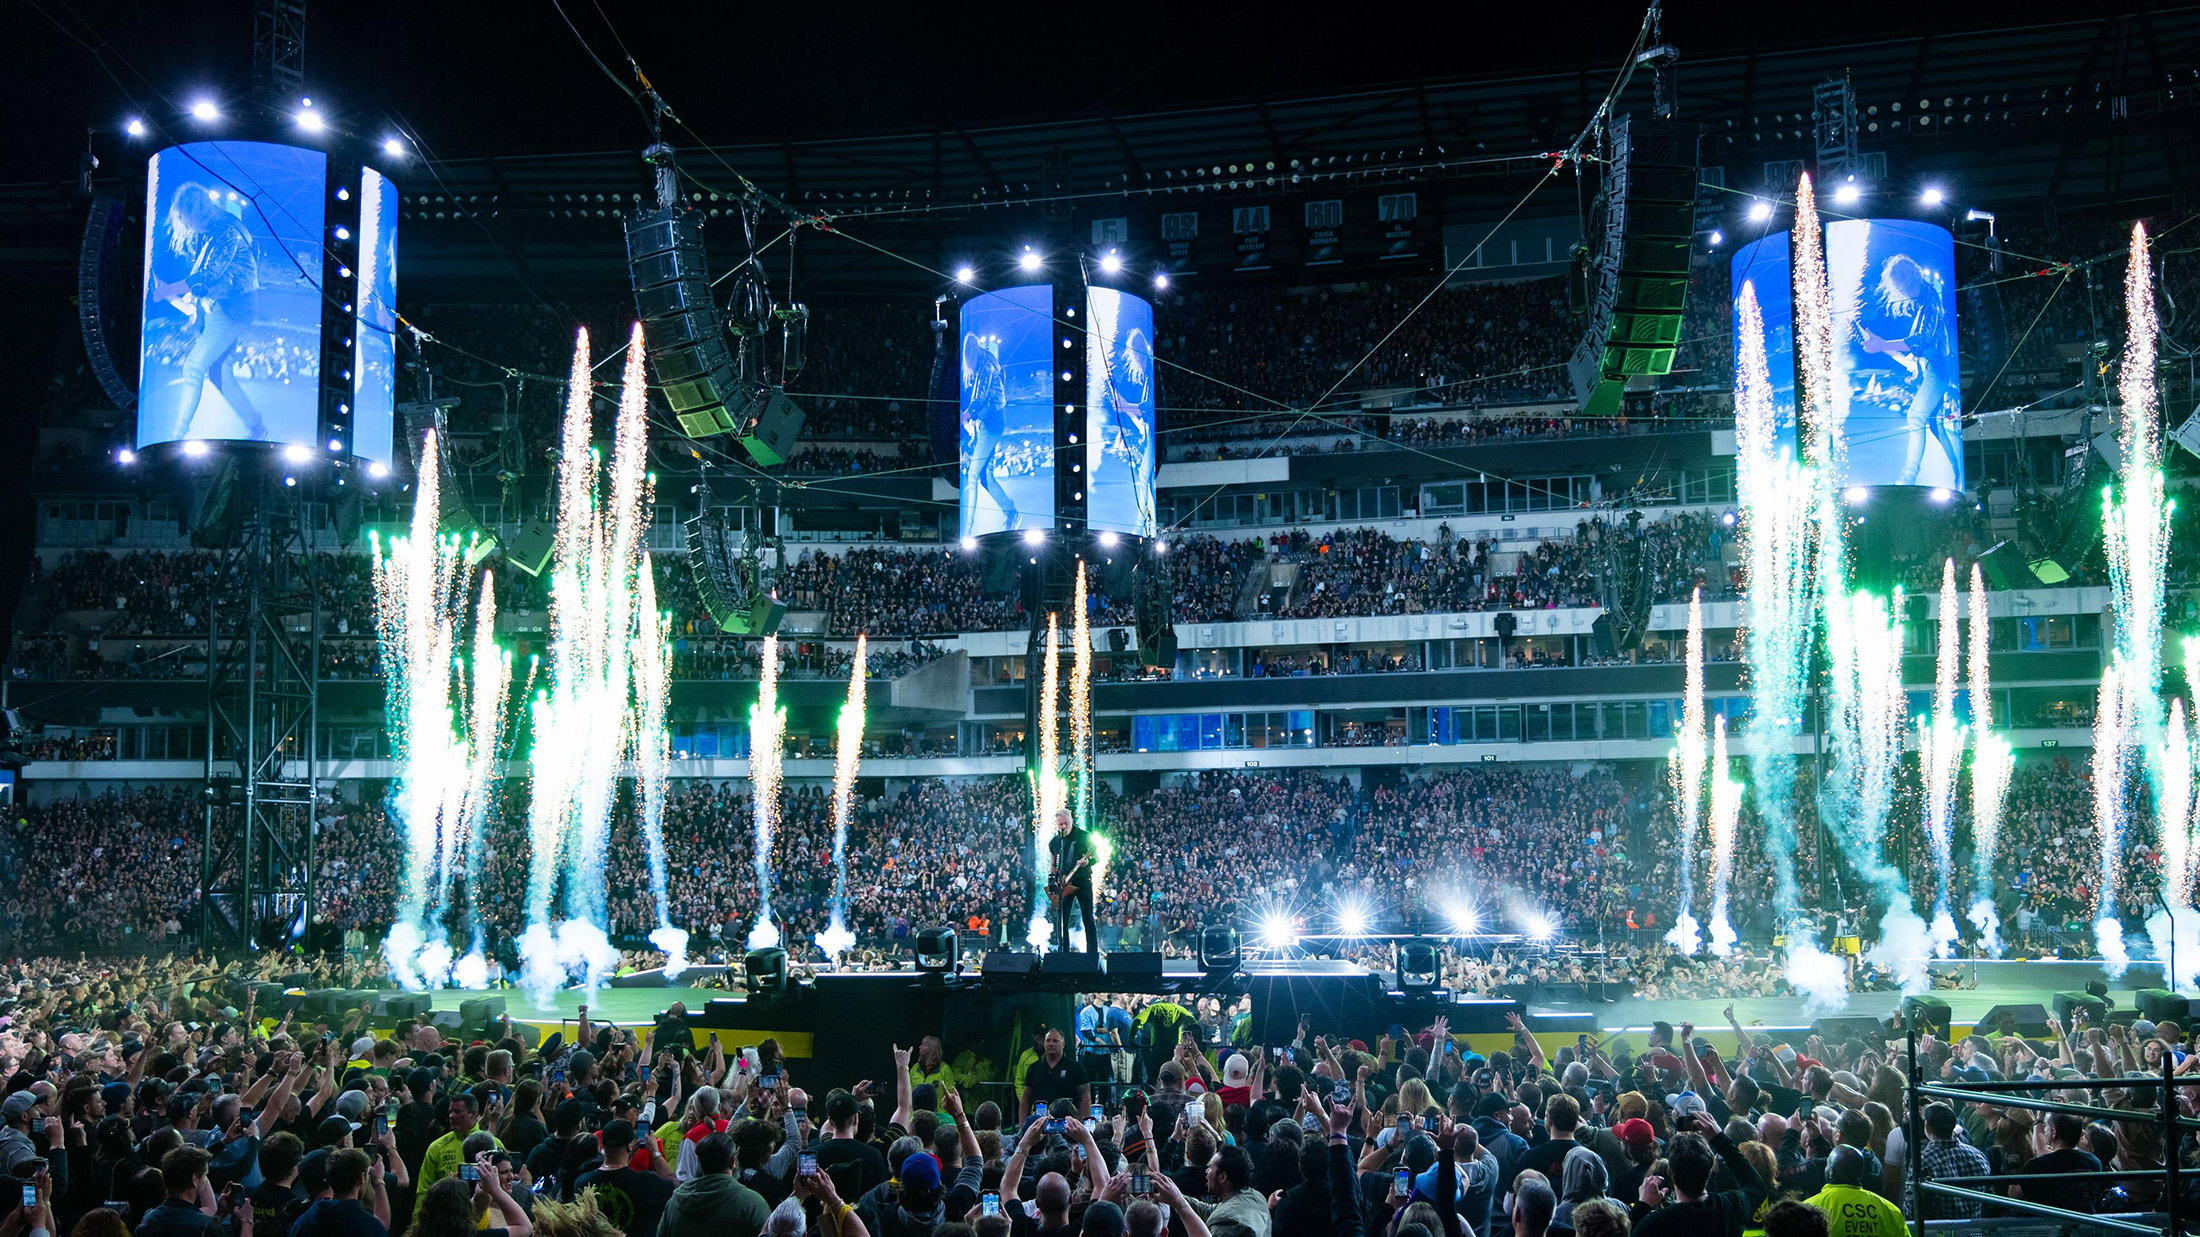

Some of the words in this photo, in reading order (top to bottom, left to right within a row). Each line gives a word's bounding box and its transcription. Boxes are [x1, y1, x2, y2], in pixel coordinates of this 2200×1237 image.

[1236, 208, 1266, 235] 44
[1308, 202, 1339, 230] 60
[1383, 195, 1414, 223] 70
[1165, 214, 1195, 241] 92
[1842, 1203, 1878, 1220] CSC
[1845, 1220, 1878, 1234] EVENT
